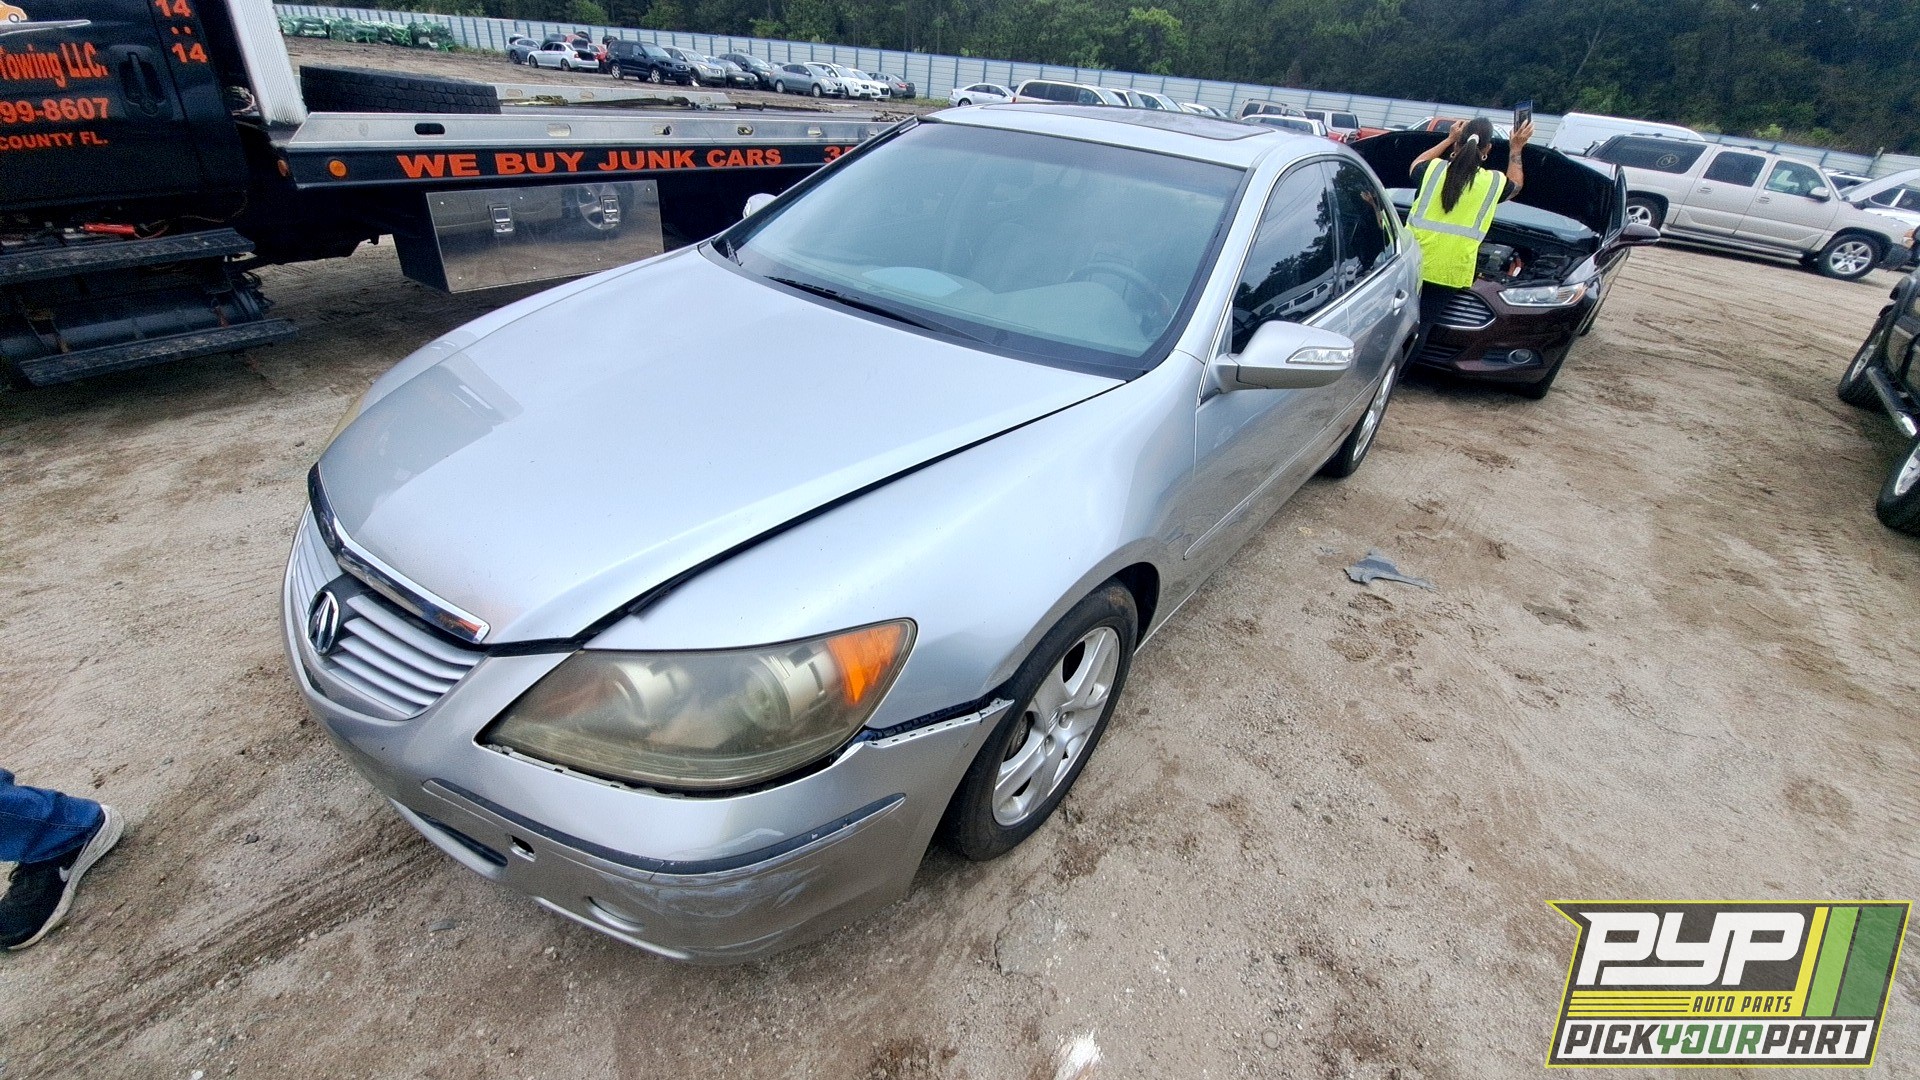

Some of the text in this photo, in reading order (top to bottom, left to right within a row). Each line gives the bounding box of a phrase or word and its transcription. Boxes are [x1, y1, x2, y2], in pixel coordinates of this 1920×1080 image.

[155, 0, 192, 17] 14
[60, 42, 108, 78] LLC.
[171, 42, 208, 63] 14
[0, 97, 109, 123] 99-8607
[0, 131, 109, 150] COUNTY FL.
[396, 153, 480, 178] WE
[494, 151, 585, 175] BUY
[598, 149, 697, 171] JUNK
[706, 148, 782, 167] CARS
